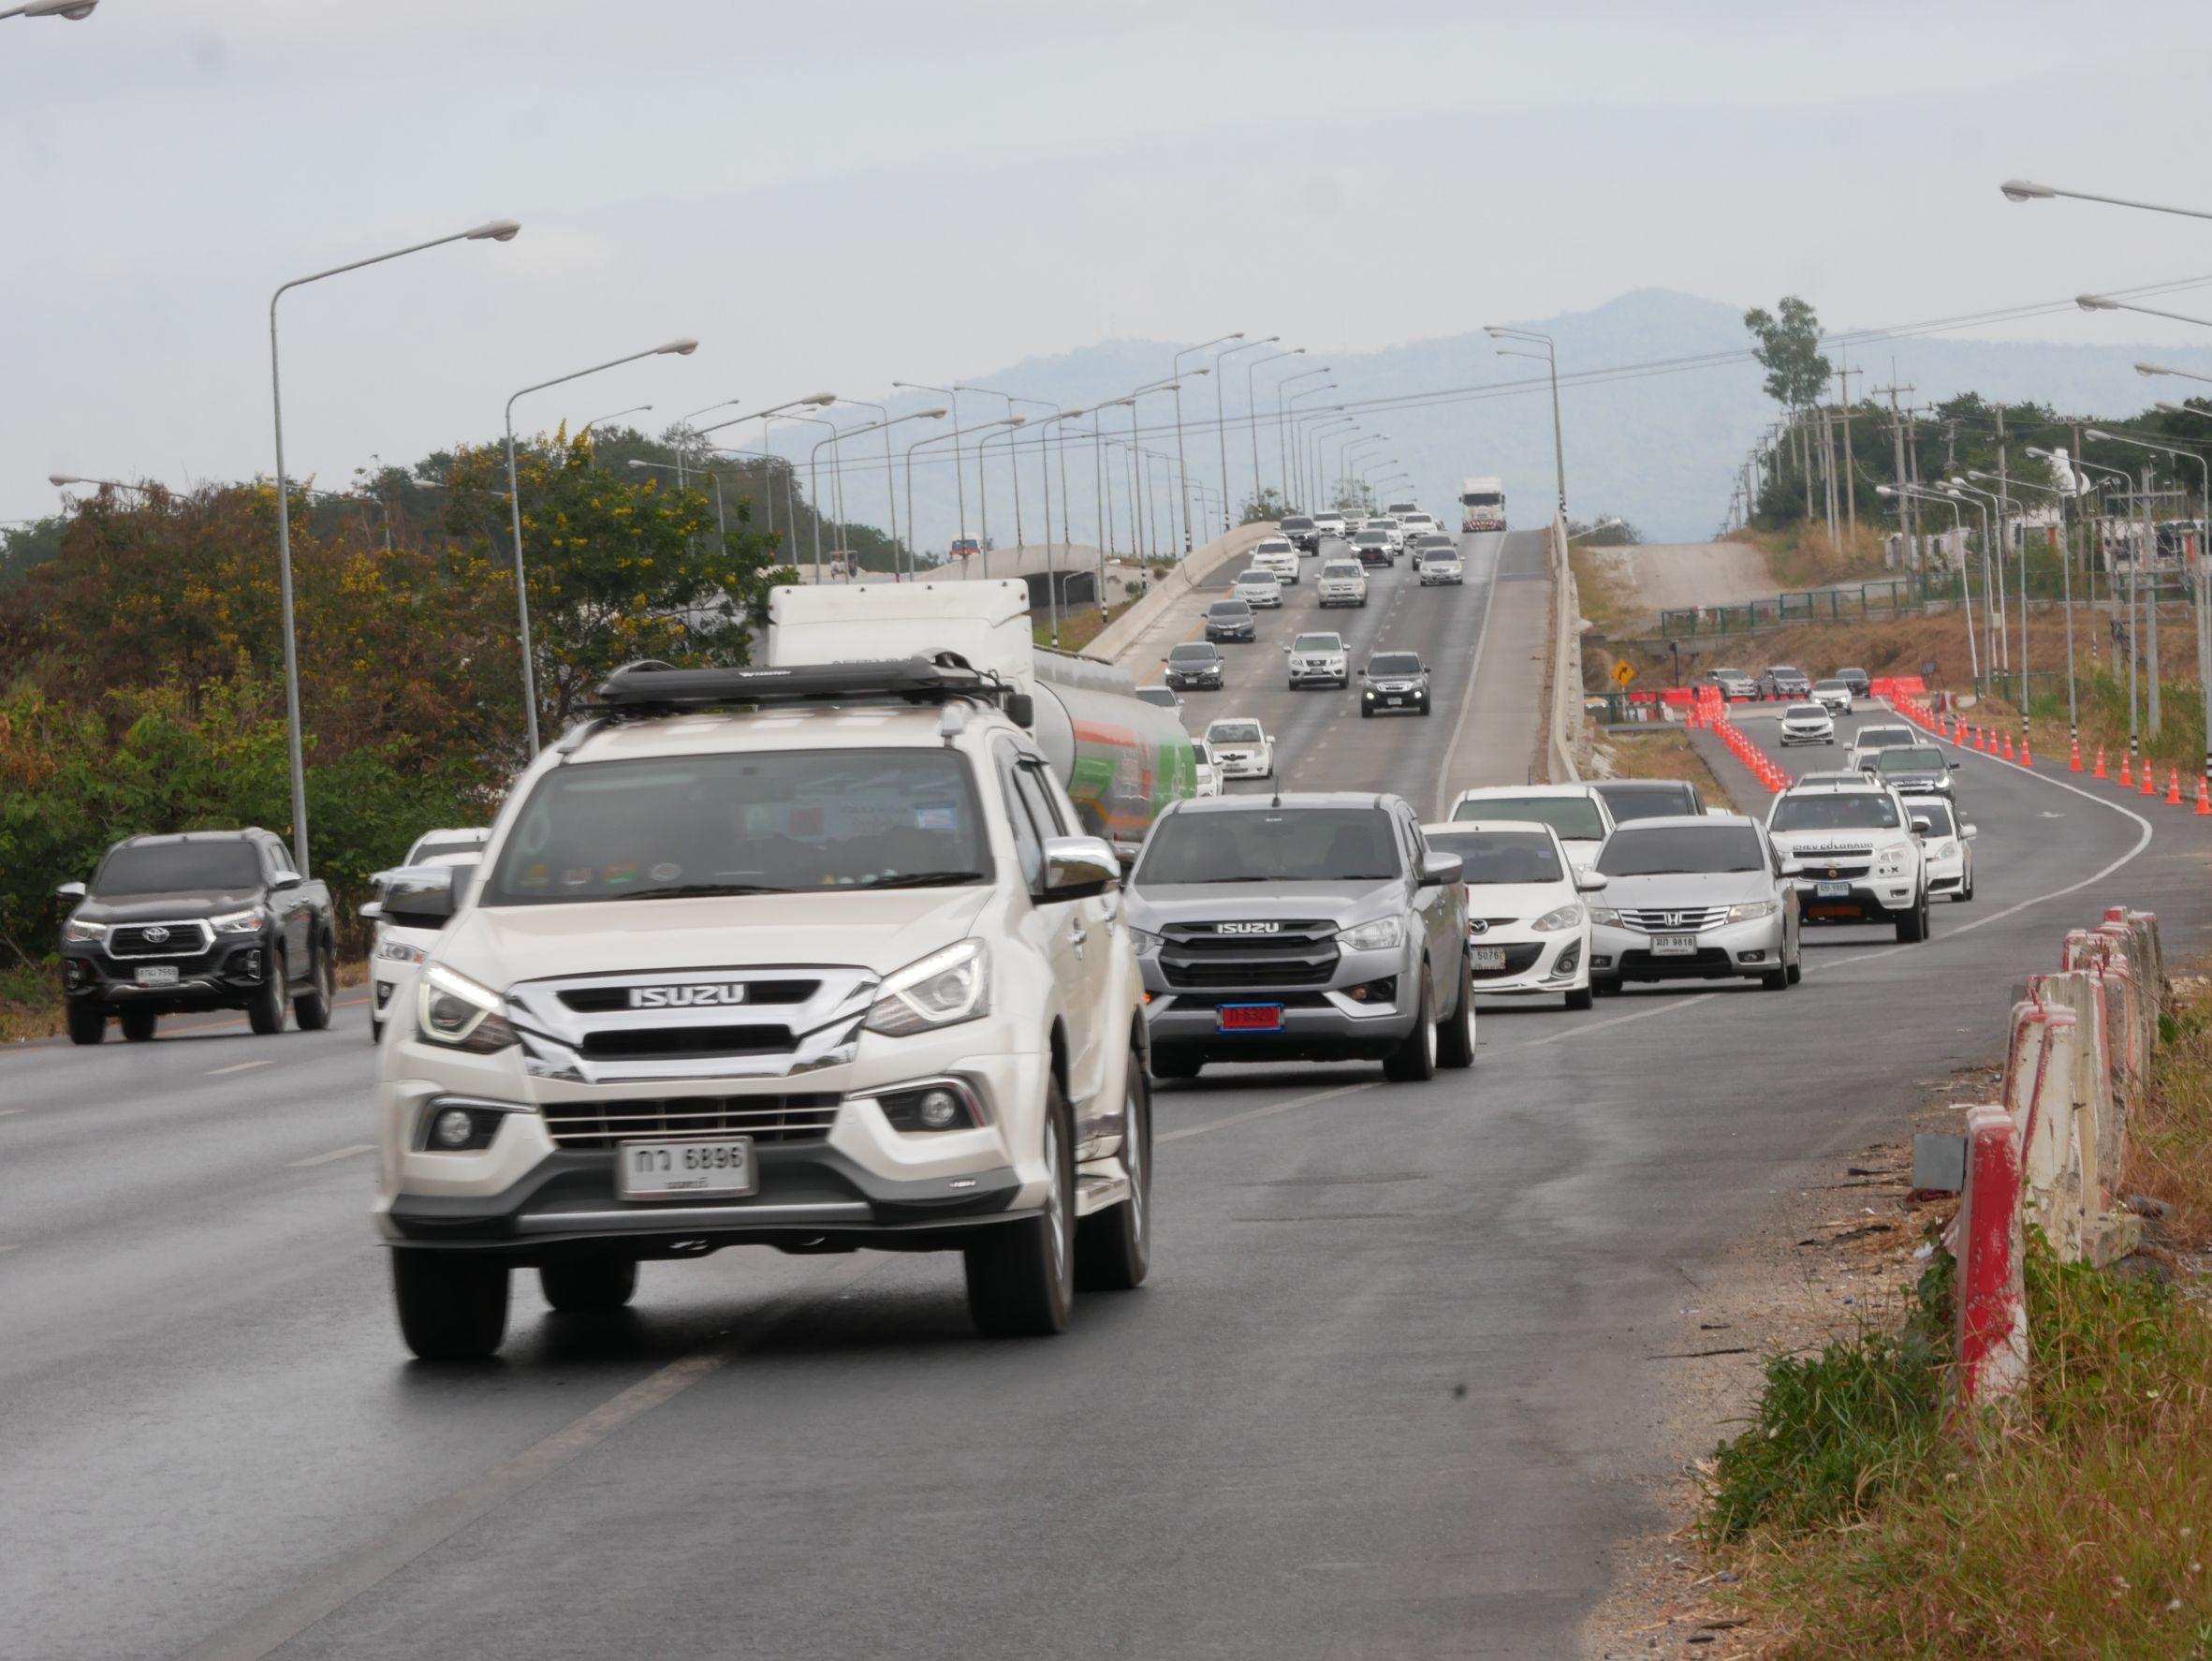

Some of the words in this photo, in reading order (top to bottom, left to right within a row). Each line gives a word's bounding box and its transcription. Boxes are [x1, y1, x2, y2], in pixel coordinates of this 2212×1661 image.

[1218, 922, 1280, 934] ISUZU
[628, 983, 745, 1008] ISUZU
[681, 1147, 744, 1170] 6896
